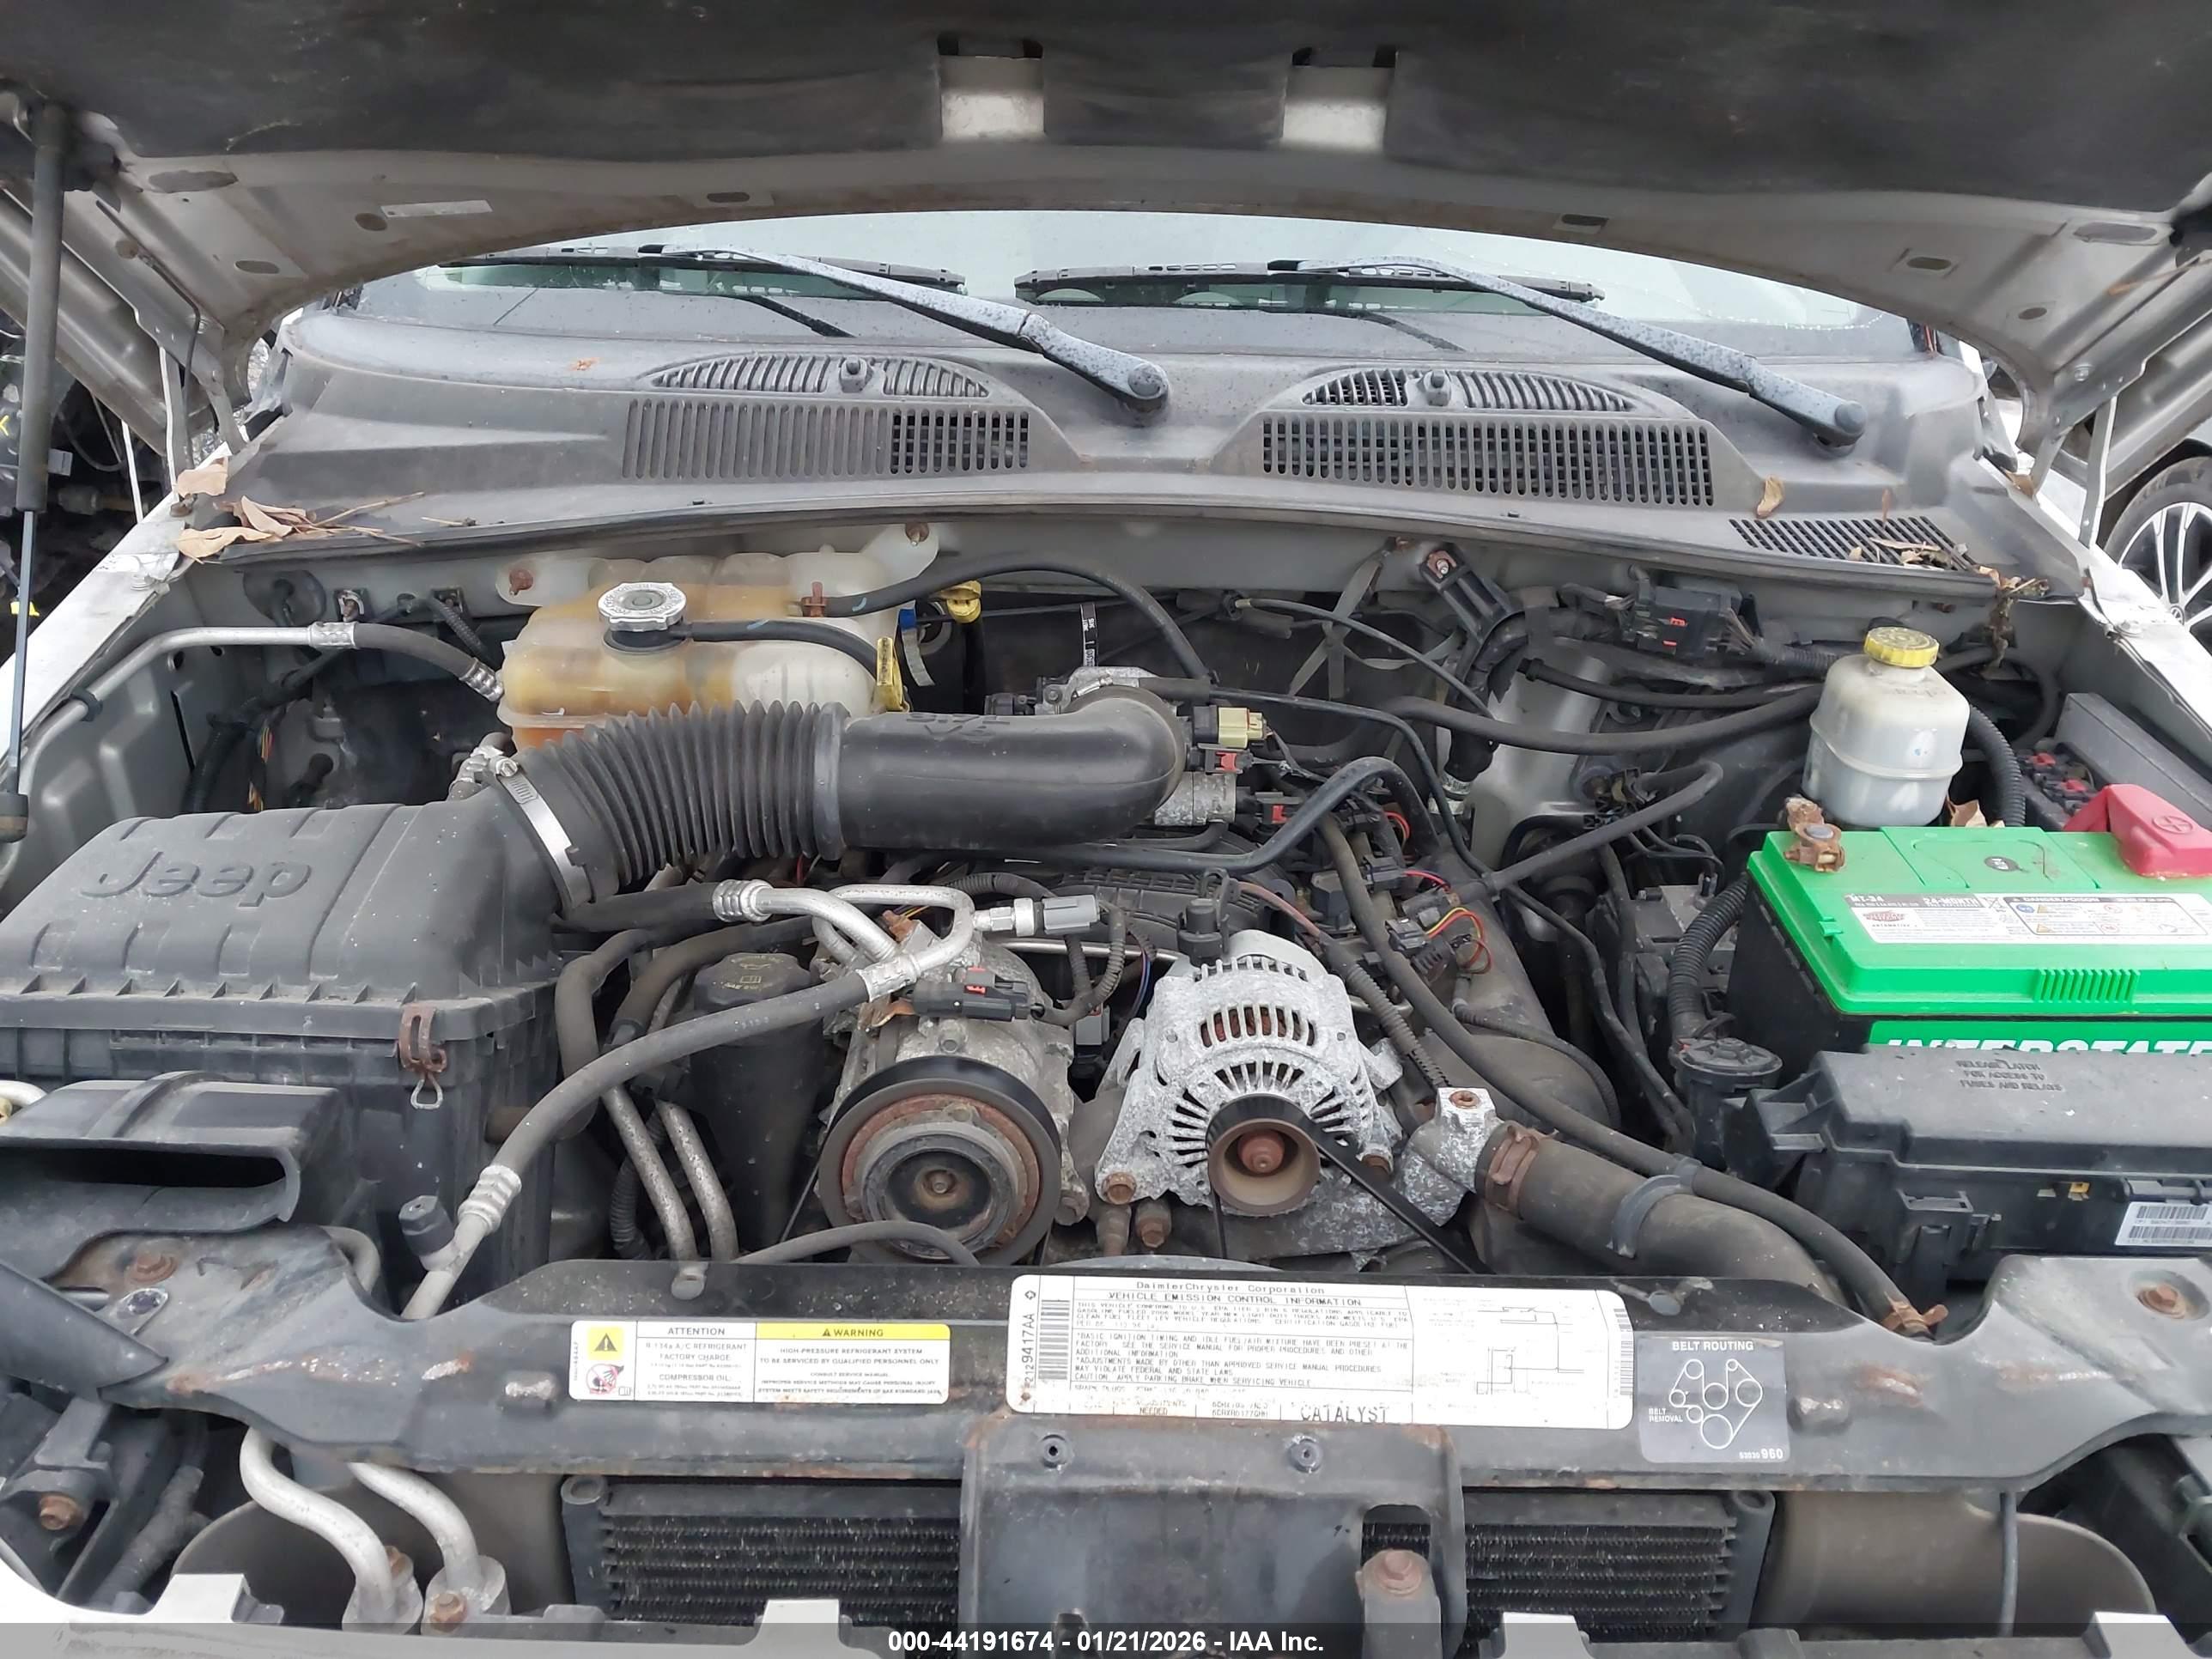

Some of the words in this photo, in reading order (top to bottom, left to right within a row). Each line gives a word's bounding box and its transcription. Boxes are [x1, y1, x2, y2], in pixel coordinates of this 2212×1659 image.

[82, 852, 310, 907] Jeep
[1136, 1281, 1238, 1293] DaimlerChrysler
[1248, 1284, 1325, 1295] Corporation
[1109, 1291, 1157, 1300] VEHICLE
[1164, 1292, 1221, 1302] EMISSION
[1228, 1294, 1277, 1304] CONTROL
[1285, 1297, 1361, 1306] INFORMATION
[667, 1327, 726, 1335] ATTENTION
[834, 1328, 884, 1338] WARNING
[1672, 1340, 1700, 1351] BELT
[1703, 1340, 1754, 1351] ROUTING
[659, 1352, 696, 1361] FACTORY
[1334, 1364, 1382, 1373] PROCEDURES
[1300, 1406, 1389, 1423] CATALYST
[1760, 1448, 1784, 1460] 960
